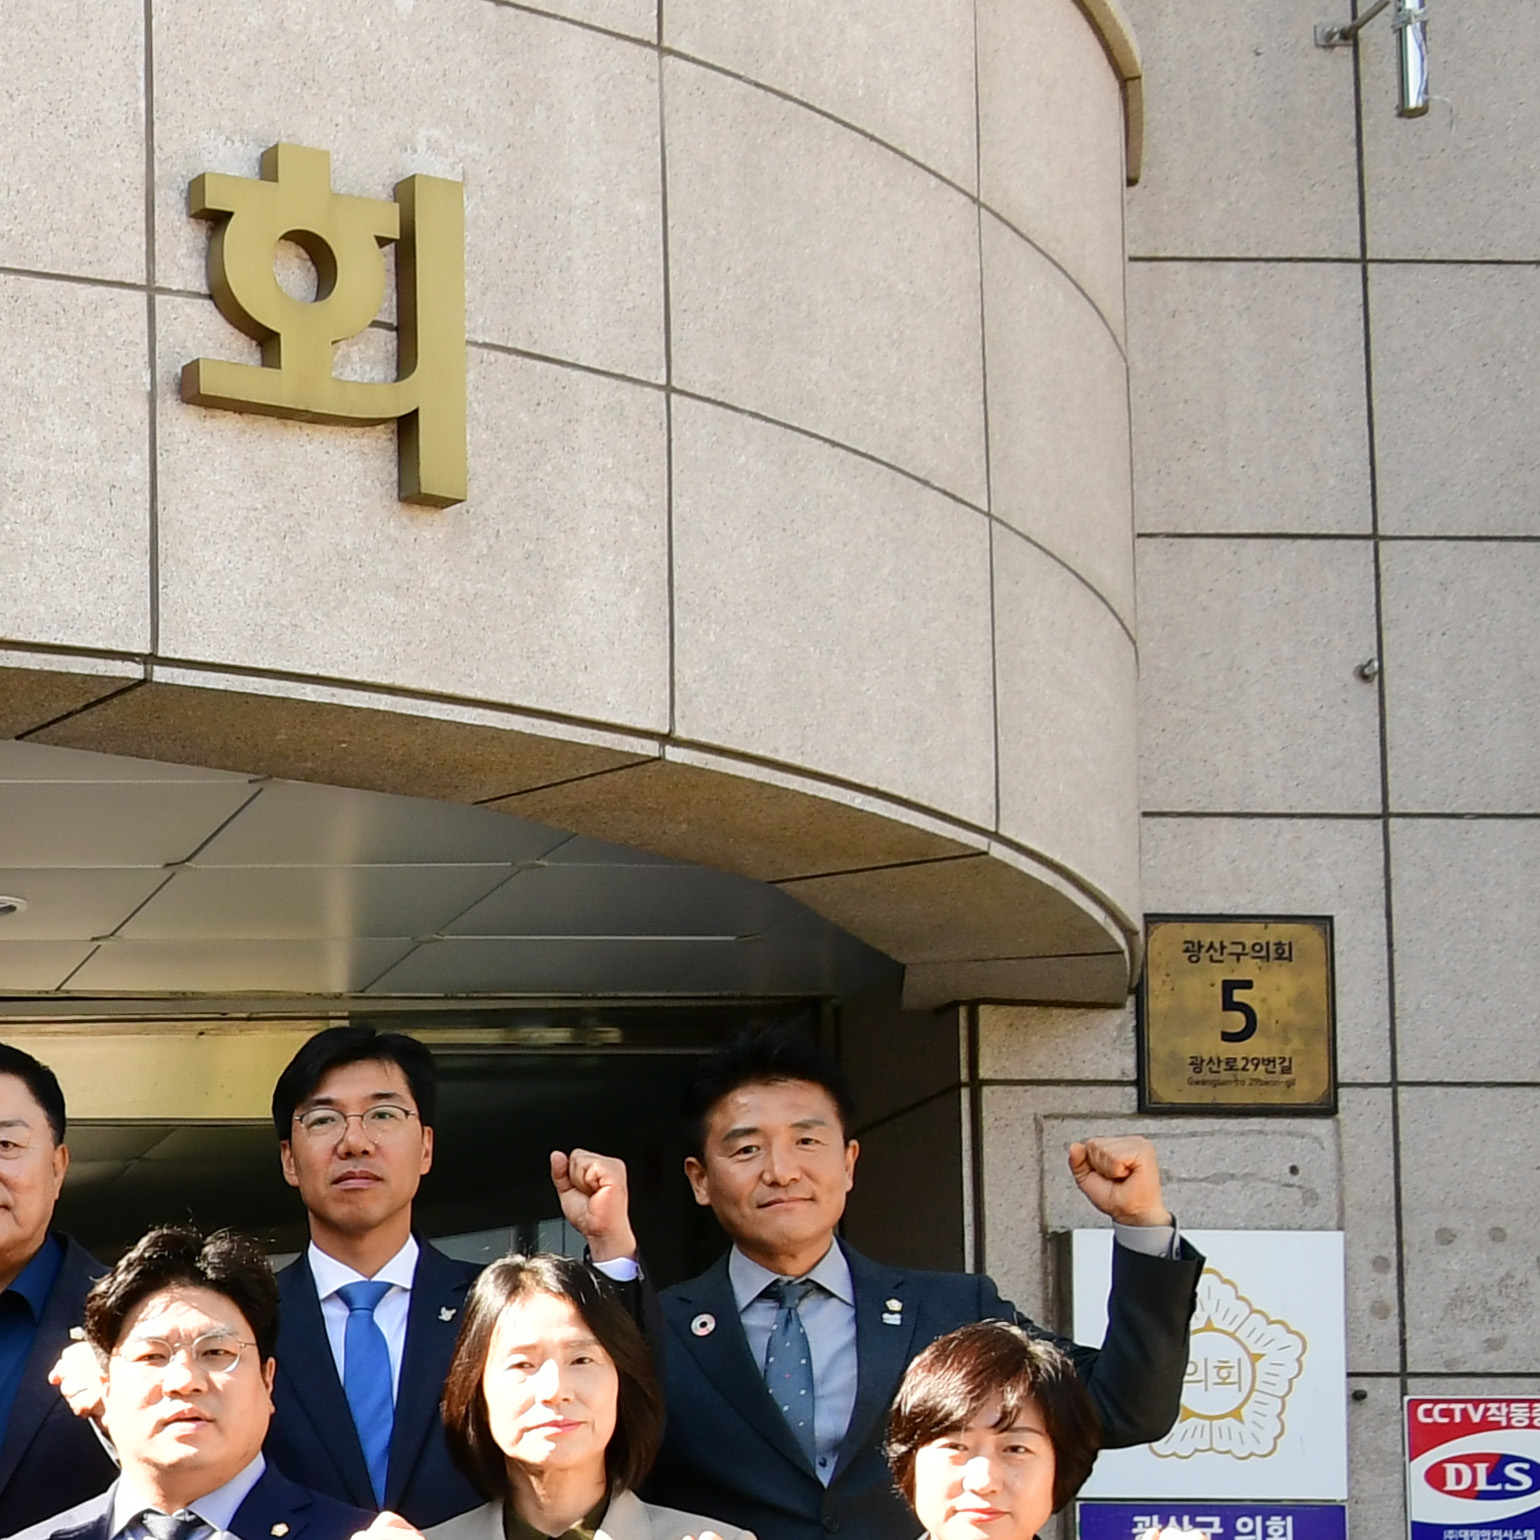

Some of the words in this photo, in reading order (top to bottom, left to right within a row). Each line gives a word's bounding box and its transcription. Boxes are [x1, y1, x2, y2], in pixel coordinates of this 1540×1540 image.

[1182, 940, 1294, 964] 광산구의회
[1220, 979, 1258, 1043] 5
[1188, 1056, 1293, 1075] 광산로29번길
[1183, 1357, 1242, 1393] 의회
[1442, 1462, 1533, 1492] DLS
